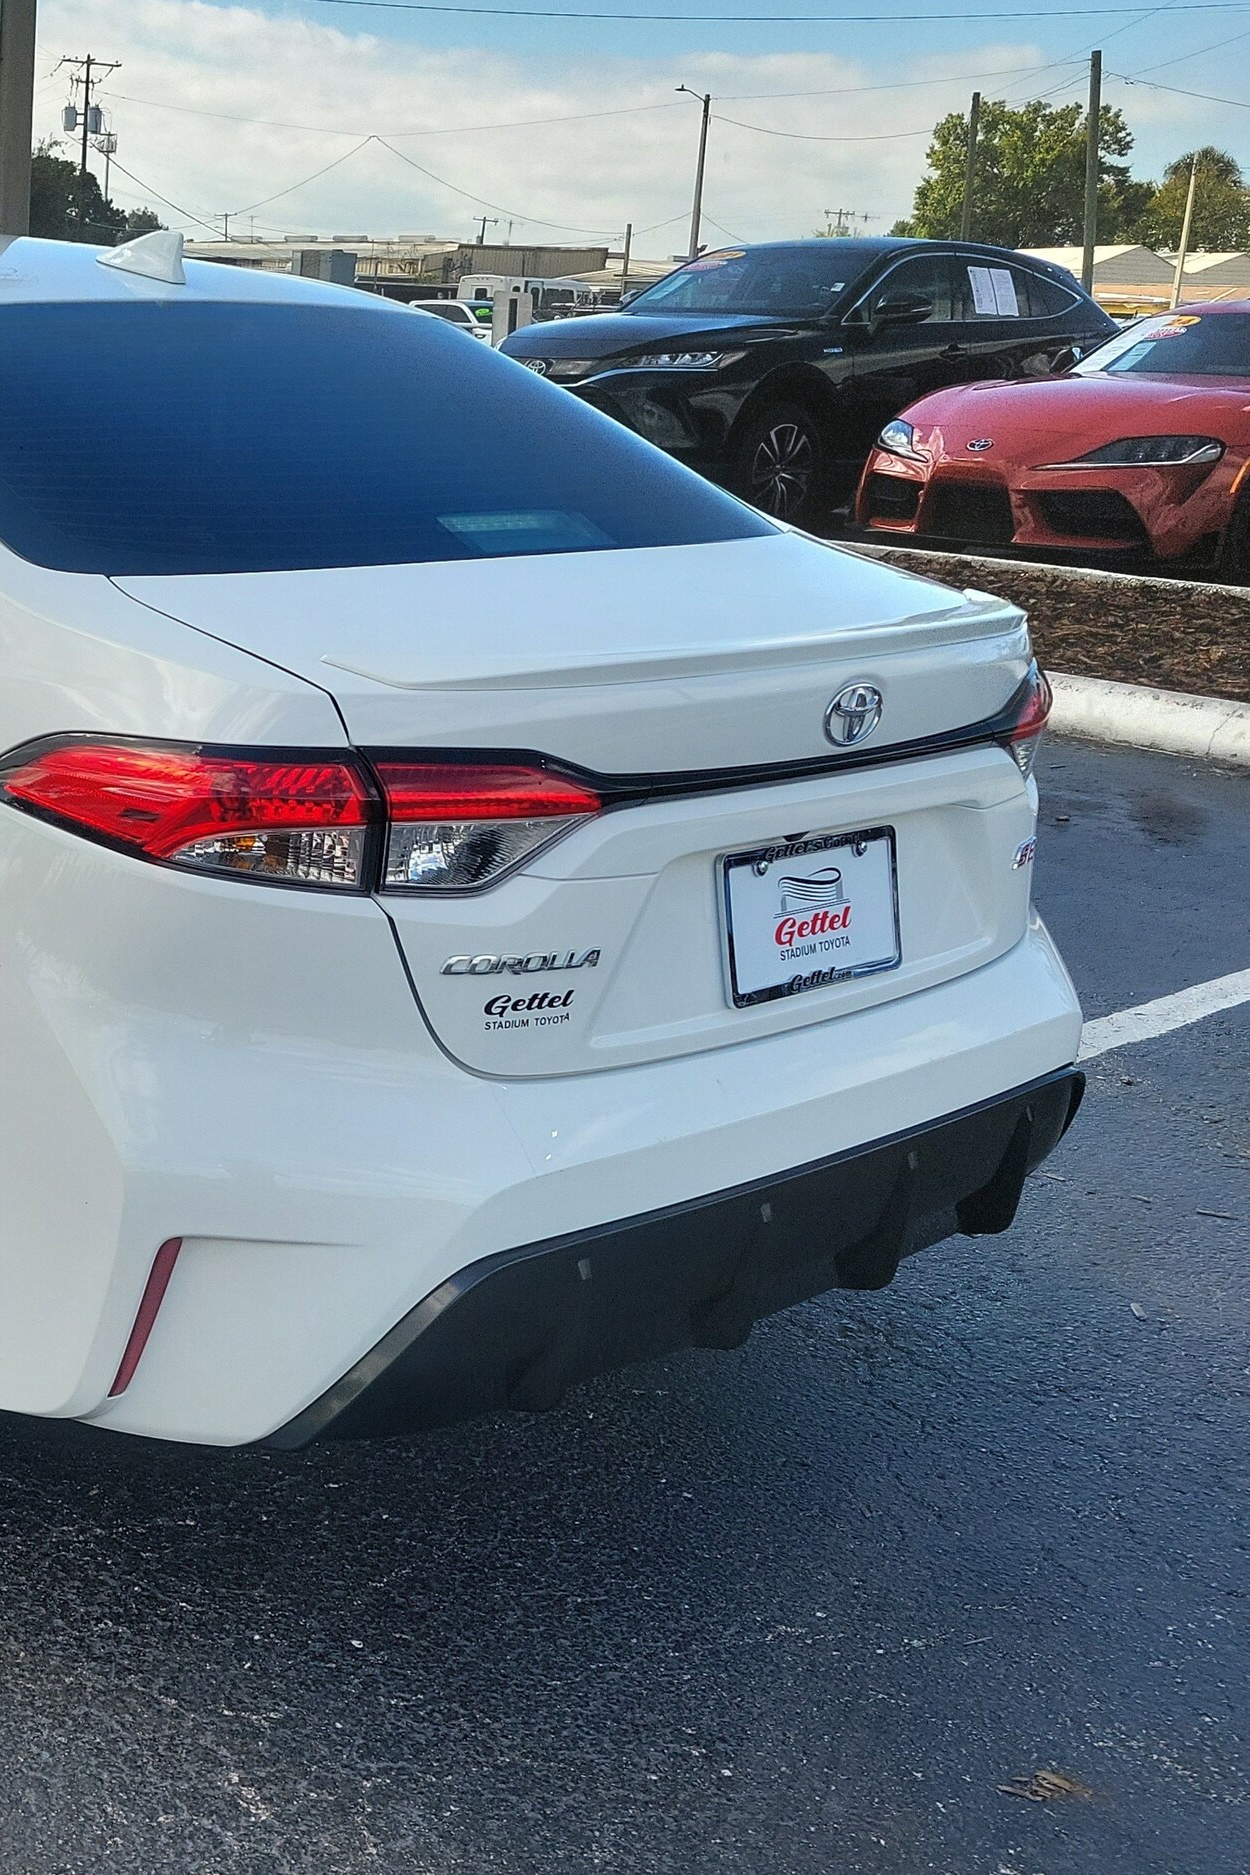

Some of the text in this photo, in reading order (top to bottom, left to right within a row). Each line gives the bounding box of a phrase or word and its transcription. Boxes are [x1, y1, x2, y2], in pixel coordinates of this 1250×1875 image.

[775, 906, 851, 946] Gettel
[439, 946, 601, 975] COROLLA
[780, 936, 851, 961] STADIUM TOYOTA
[483, 989, 575, 1017] Gettel
[484, 1012, 570, 1031] STADIUM TOYOTA
